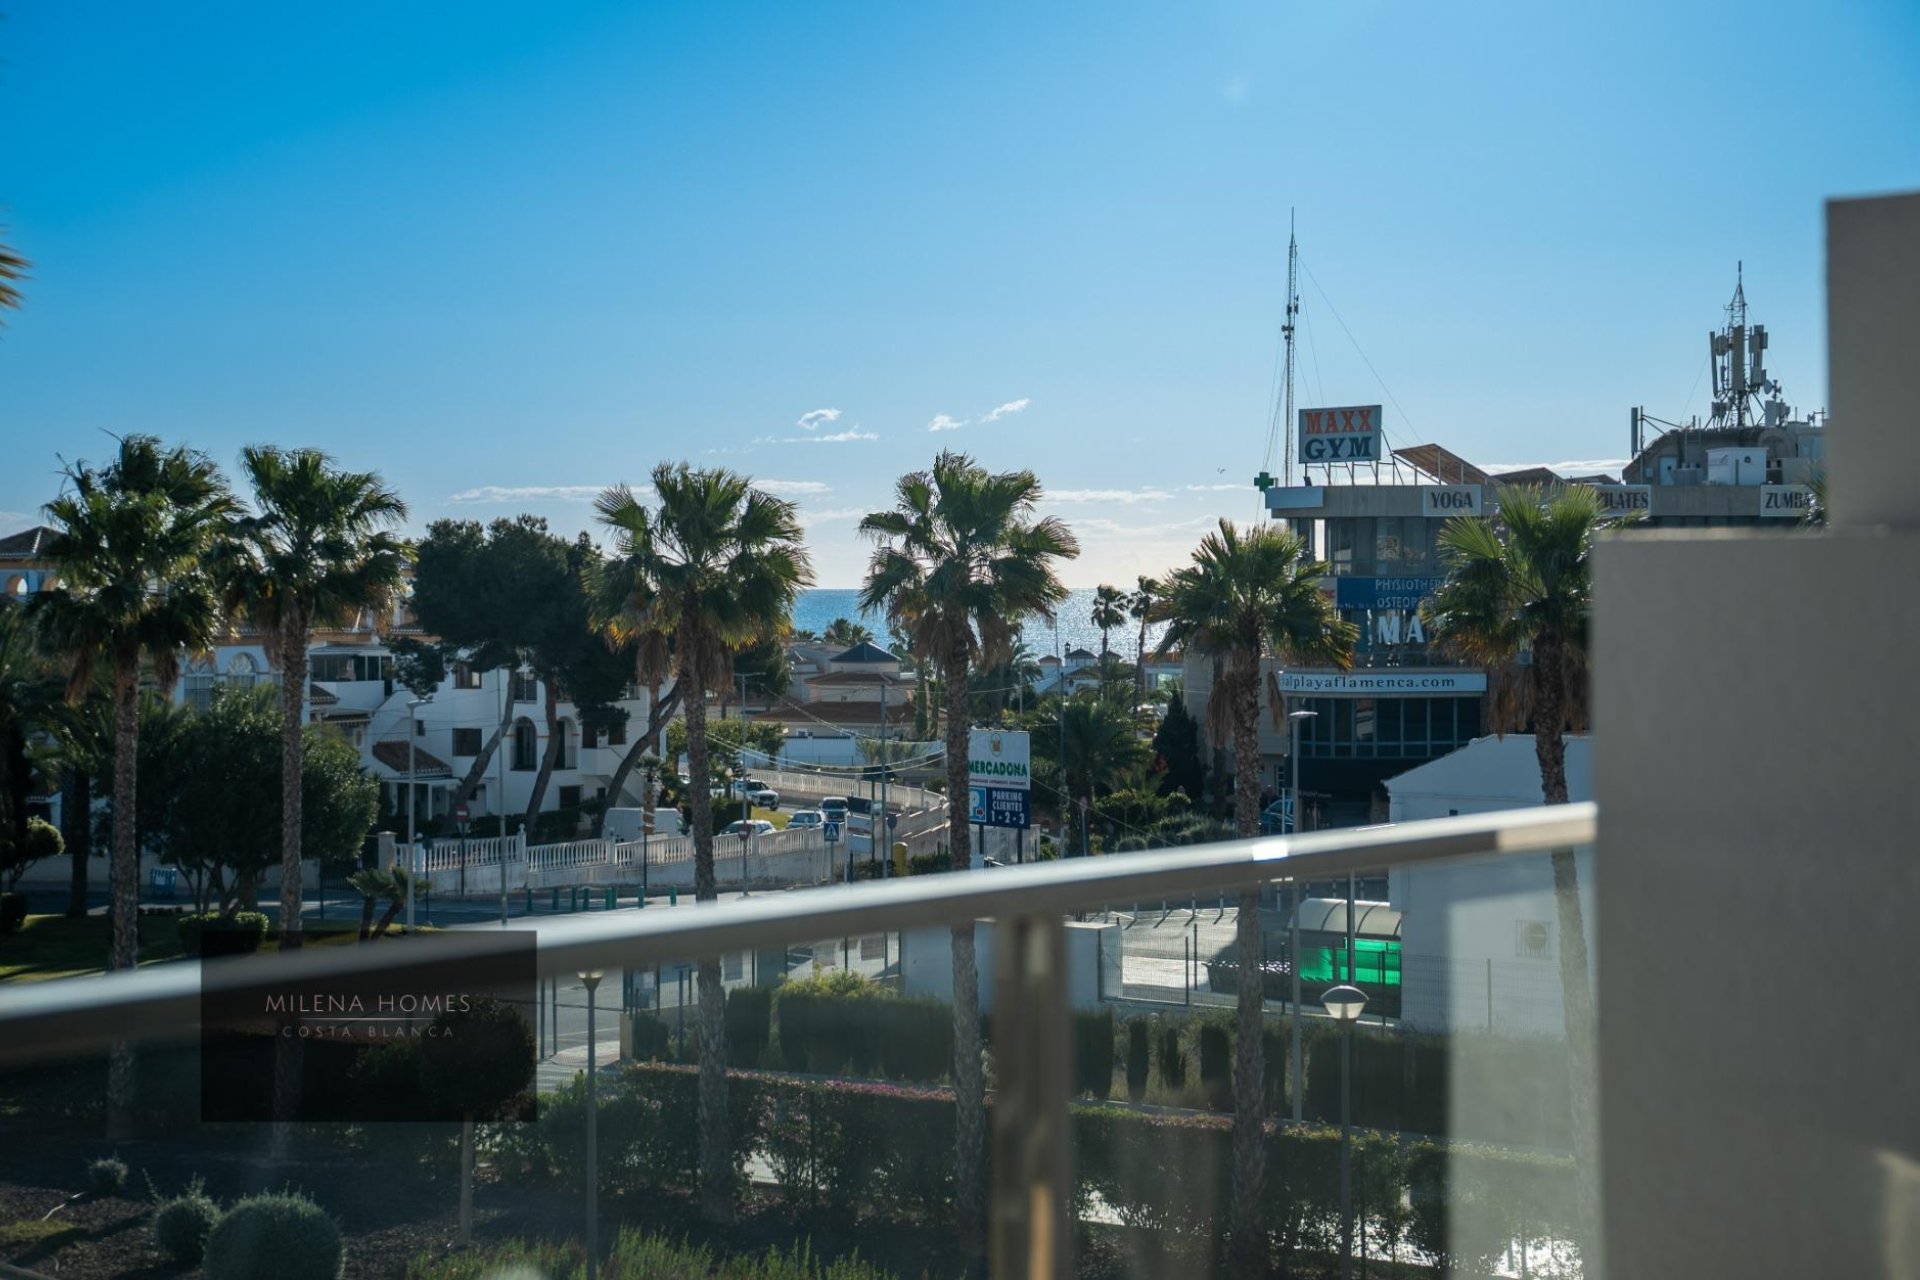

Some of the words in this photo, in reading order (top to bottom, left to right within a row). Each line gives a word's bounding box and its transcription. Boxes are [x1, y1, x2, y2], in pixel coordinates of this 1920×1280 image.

[1304, 410, 1373, 434] MAXX
[1304, 436, 1372, 460] GYM
[1430, 491, 1473, 509] YOGA
[1375, 578, 1443, 591] PHYSIOTHER
[1376, 596, 1422, 609] OSTEOP
[1378, 615, 1426, 644] MA
[968, 760, 1028, 777] MERCADONA
[992, 790, 1023, 801] PARKING
[992, 800, 1023, 812] CLIENTES
